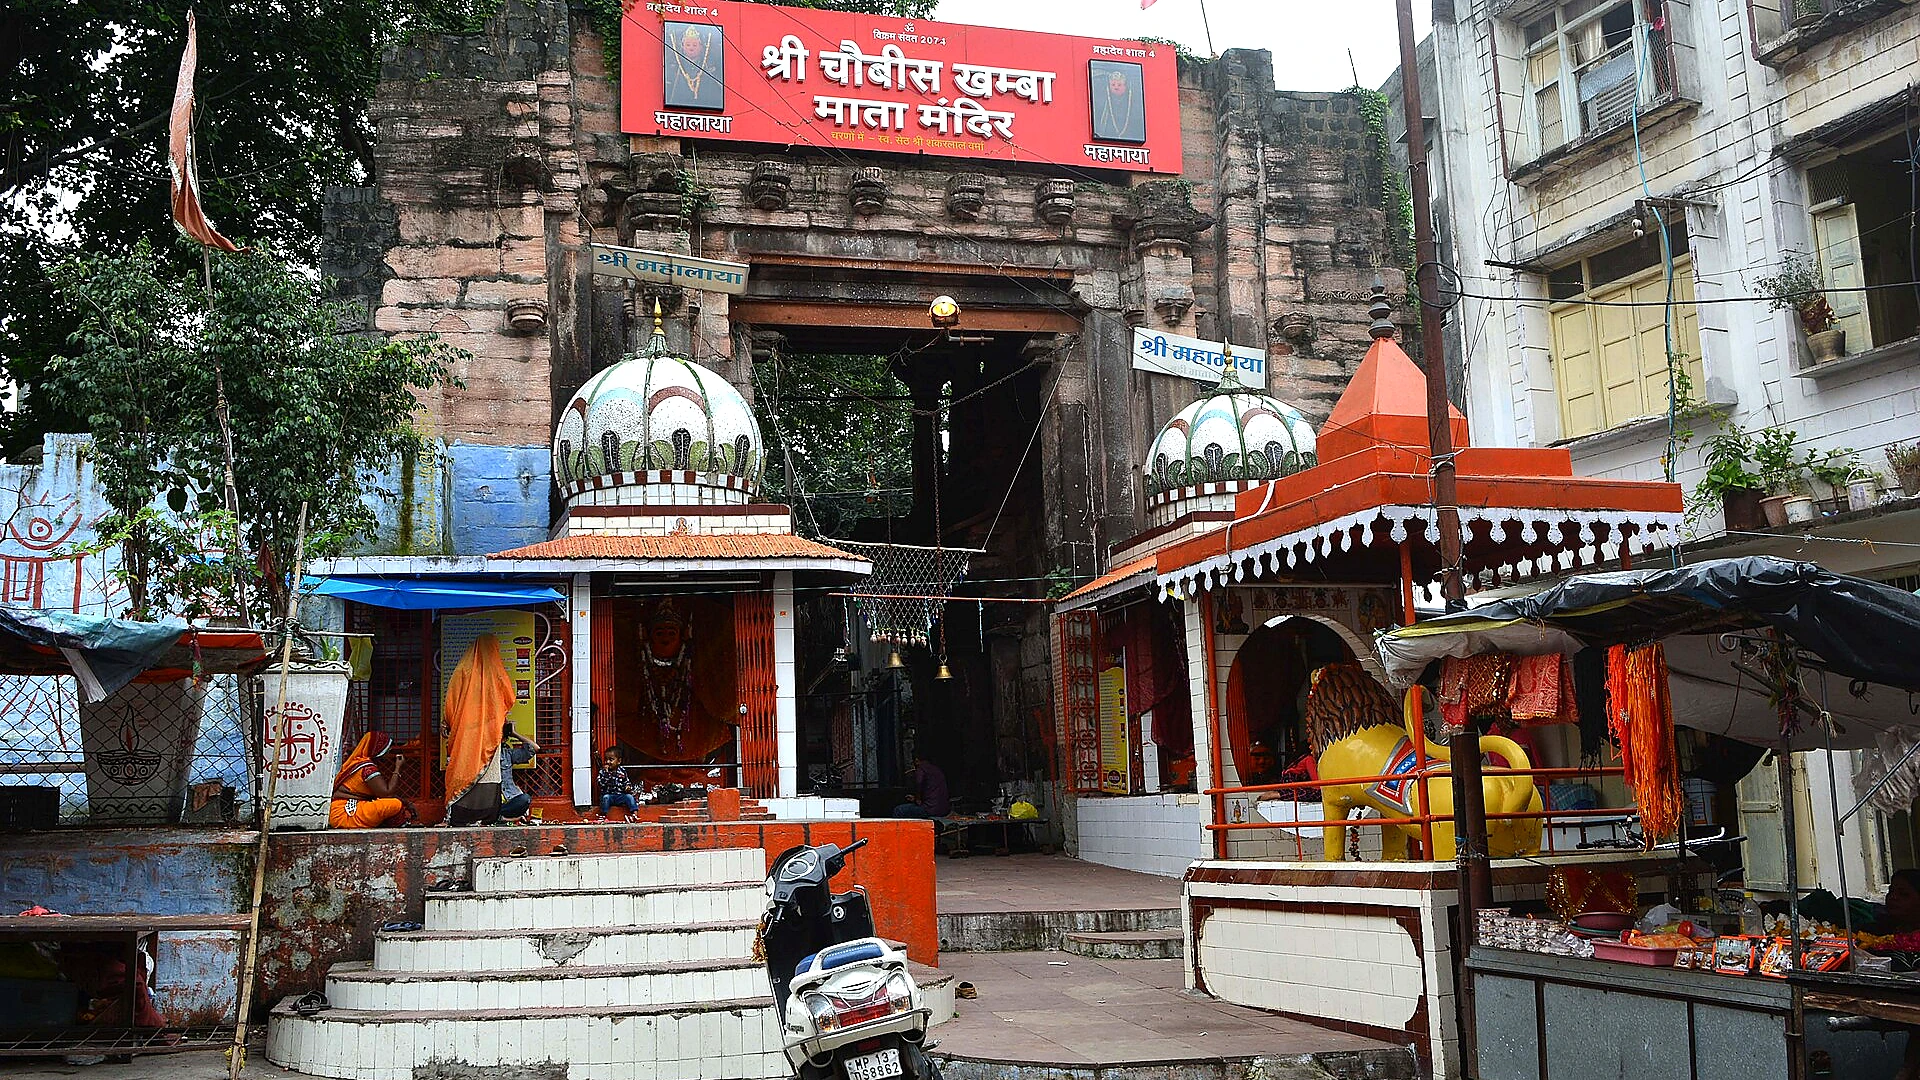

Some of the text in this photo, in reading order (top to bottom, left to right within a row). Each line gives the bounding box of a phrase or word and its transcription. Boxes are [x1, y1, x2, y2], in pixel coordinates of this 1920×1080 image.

[684, 5, 708, 16] शाल
[711, 9, 719, 17] 4
[873, 29, 897, 41] विक्रम
[921, 36, 947, 46] 2074
[1126, 49, 1147, 58] शाल
[1149, 50, 1156, 58] 4
[760, 34, 1057, 104] श्री चौबीस खम्बा
[654, 111, 733, 134] महालाया
[813, 95, 1016, 140] माता मंदिर
[831, 130, 856, 143] चरणों
[857, 131, 866, 143] में
[896, 134, 911, 146] सेठ
[912, 135, 924, 147] श्री
[926, 137, 966, 150] शंकरलाल
[967, 140, 985, 151] वर्मा
[1083, 143, 1151, 164] महामाया
[597, 251, 744, 285] श्री महालाया
[1140, 335, 1168, 358] श्री
[1172, 344, 1264, 373] महामाया
[853, 1061, 900, 1080] DS8862
[855, 1051, 890, 1071] MP 13
